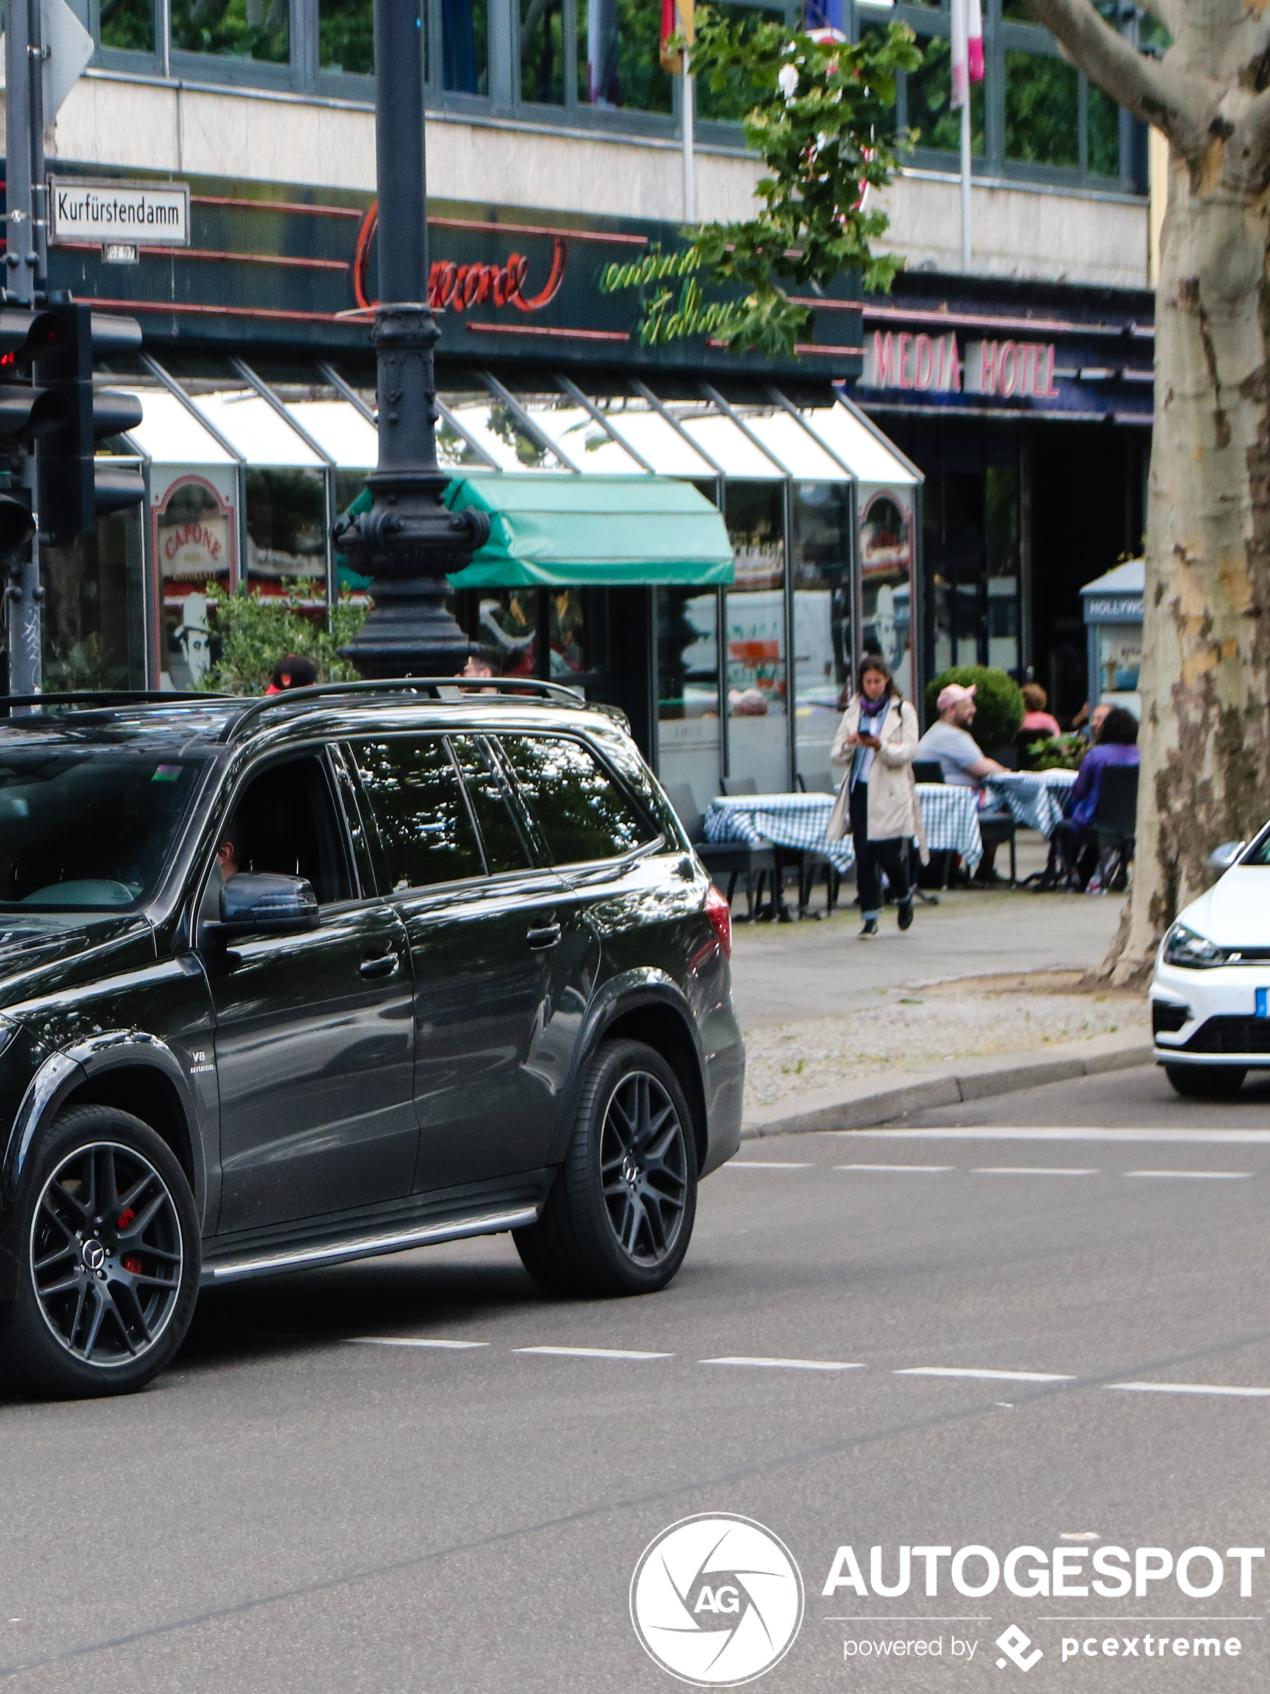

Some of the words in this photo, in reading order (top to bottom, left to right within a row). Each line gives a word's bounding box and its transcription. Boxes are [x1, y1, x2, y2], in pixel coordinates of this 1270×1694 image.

[58, 192, 180, 225] Kurfürstendamm
[872, 329, 962, 393] MEDIA
[980, 339, 1060, 399] HOTEL
[164, 522, 222, 561] CAPONE
[192, 1051, 205, 1062] V8
